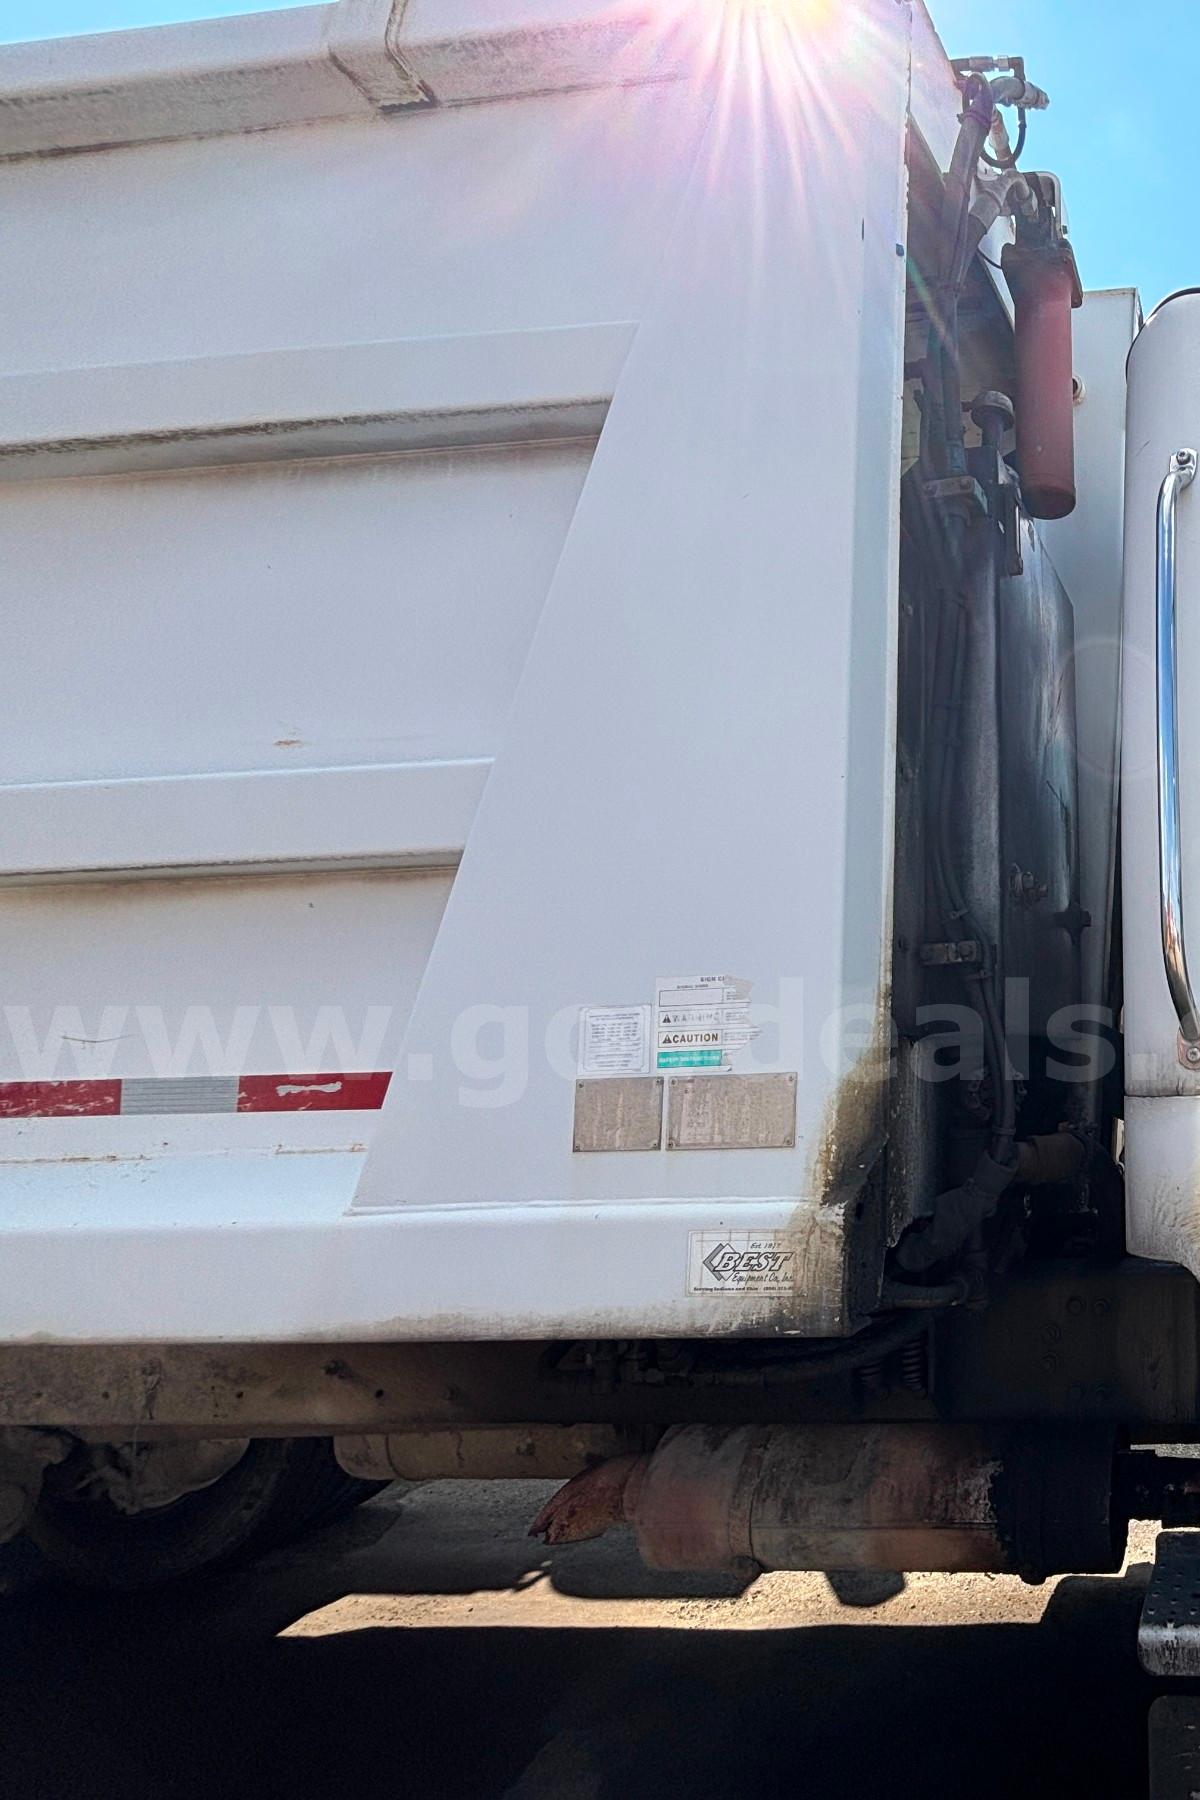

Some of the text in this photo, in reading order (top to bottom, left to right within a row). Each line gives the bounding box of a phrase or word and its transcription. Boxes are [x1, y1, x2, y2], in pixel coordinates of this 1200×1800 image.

[672, 1033, 719, 1044] CAUTION
[713, 1251, 794, 1272] BEST
[732, 1272, 768, 1285] Equipment
